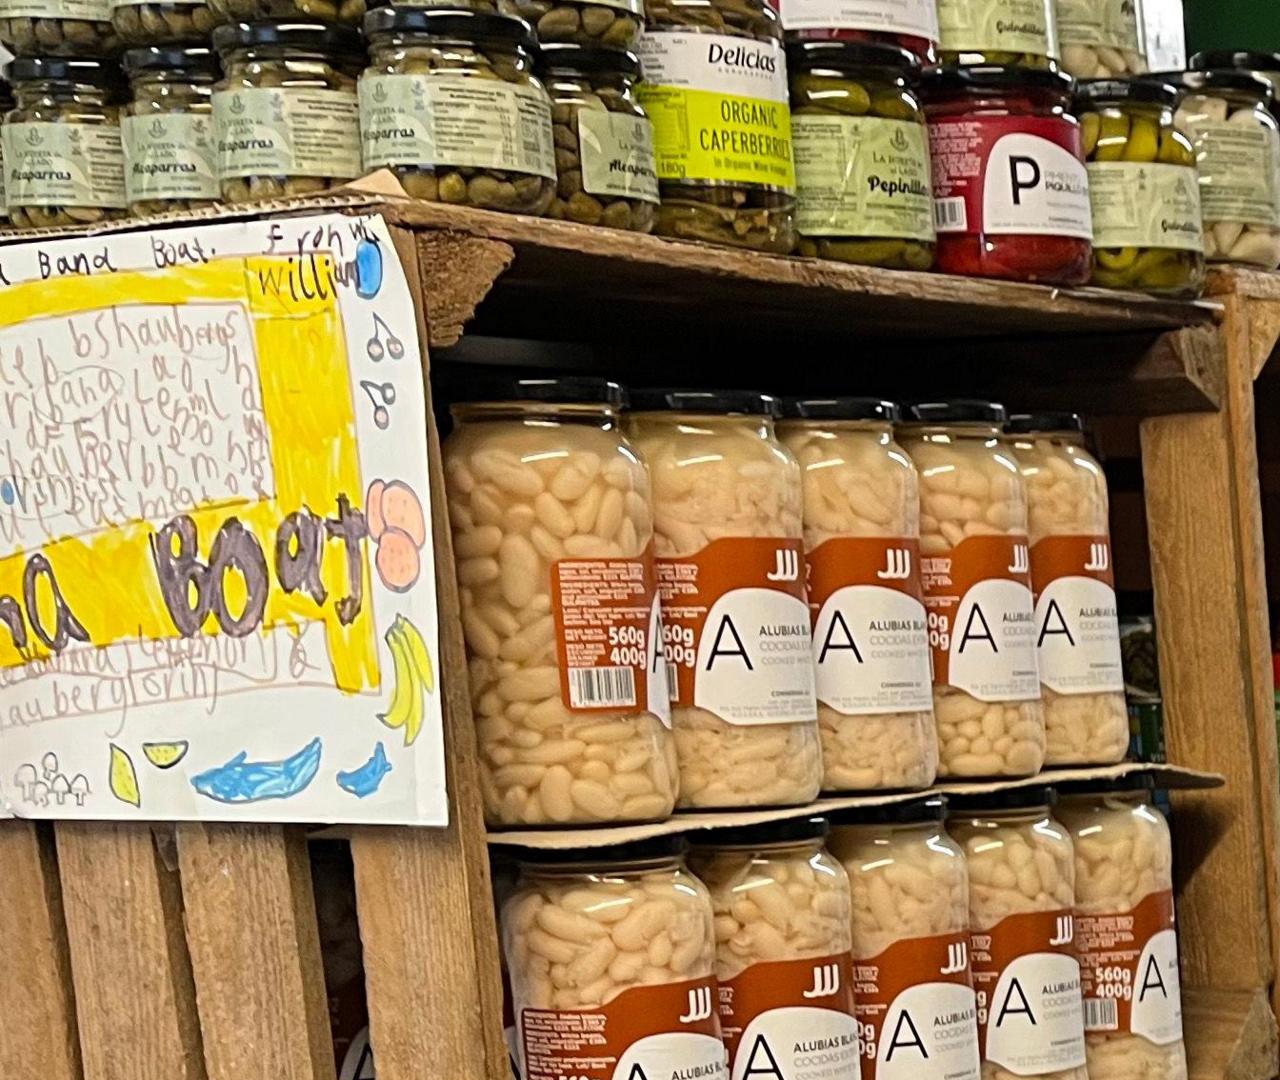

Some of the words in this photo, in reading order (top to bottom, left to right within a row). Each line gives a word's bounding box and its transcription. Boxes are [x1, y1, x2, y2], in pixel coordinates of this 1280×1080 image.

[708, 44, 776, 73] Delicias
[721, 100, 778, 129] ORGANIC
[1009, 155, 1041, 205] P
[608, 626, 645, 649] 560g
[706, 614, 754, 671] A
[818, 609, 864, 664] A
[958, 602, 999, 653] A
[1036, 598, 1076, 648] A
[610, 646, 647, 670] 400g
[1095, 966, 1131, 983] 560g
[1096, 981, 1132, 1000] 400g
[1138, 953, 1168, 1003] A
[996, 977, 1037, 1028] A
[793, 1036, 840, 1054] ALUBIAS
[885, 1008, 929, 1061] A
